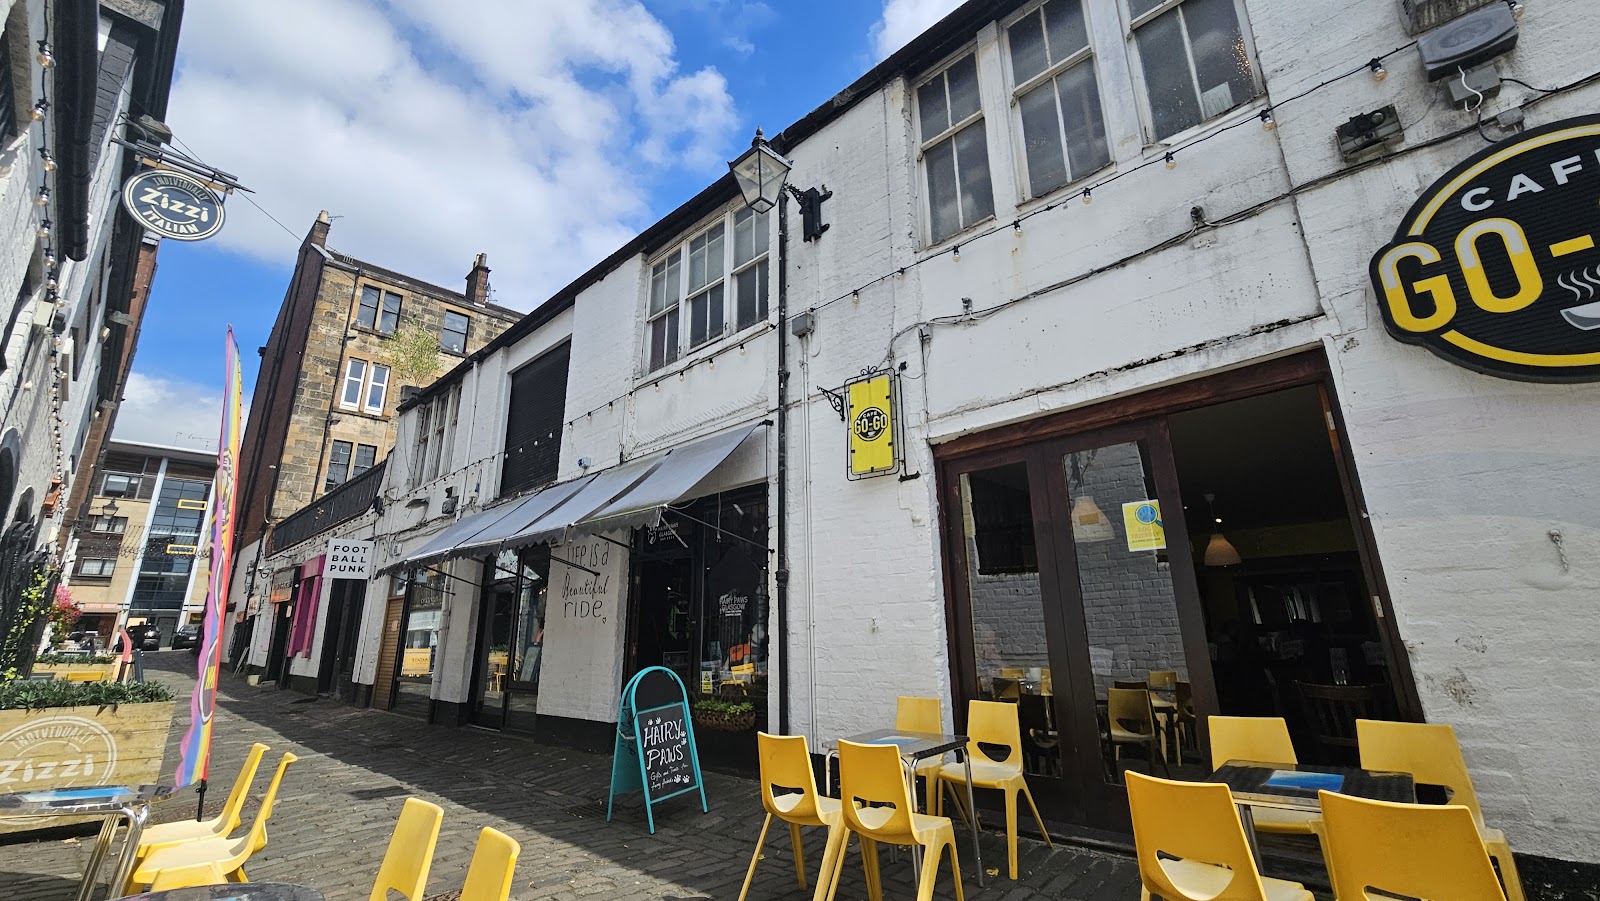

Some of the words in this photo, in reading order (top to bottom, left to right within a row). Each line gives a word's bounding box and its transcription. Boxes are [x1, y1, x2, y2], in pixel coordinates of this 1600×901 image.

[152, 176, 209, 201] INDIVIDUALLY
[1460, 149, 1600, 212] CAF
[139, 187, 208, 222] Zizzi
[142, 210, 199, 234] ITALIAN
[1378, 217, 1600, 333] GO-
[854, 413, 888, 434] GO-GO
[331, 554, 367, 563] BALL
[333, 545, 369, 554] FOOT
[329, 564, 365, 573] PUNK
[562, 572, 610, 600] Beautiful
[9, 725, 96, 750] INDIVIDUALLY
[643, 719, 682, 748] HAIRY
[0, 754, 94, 785] Zizzi
[646, 744, 684, 770] PAWS
